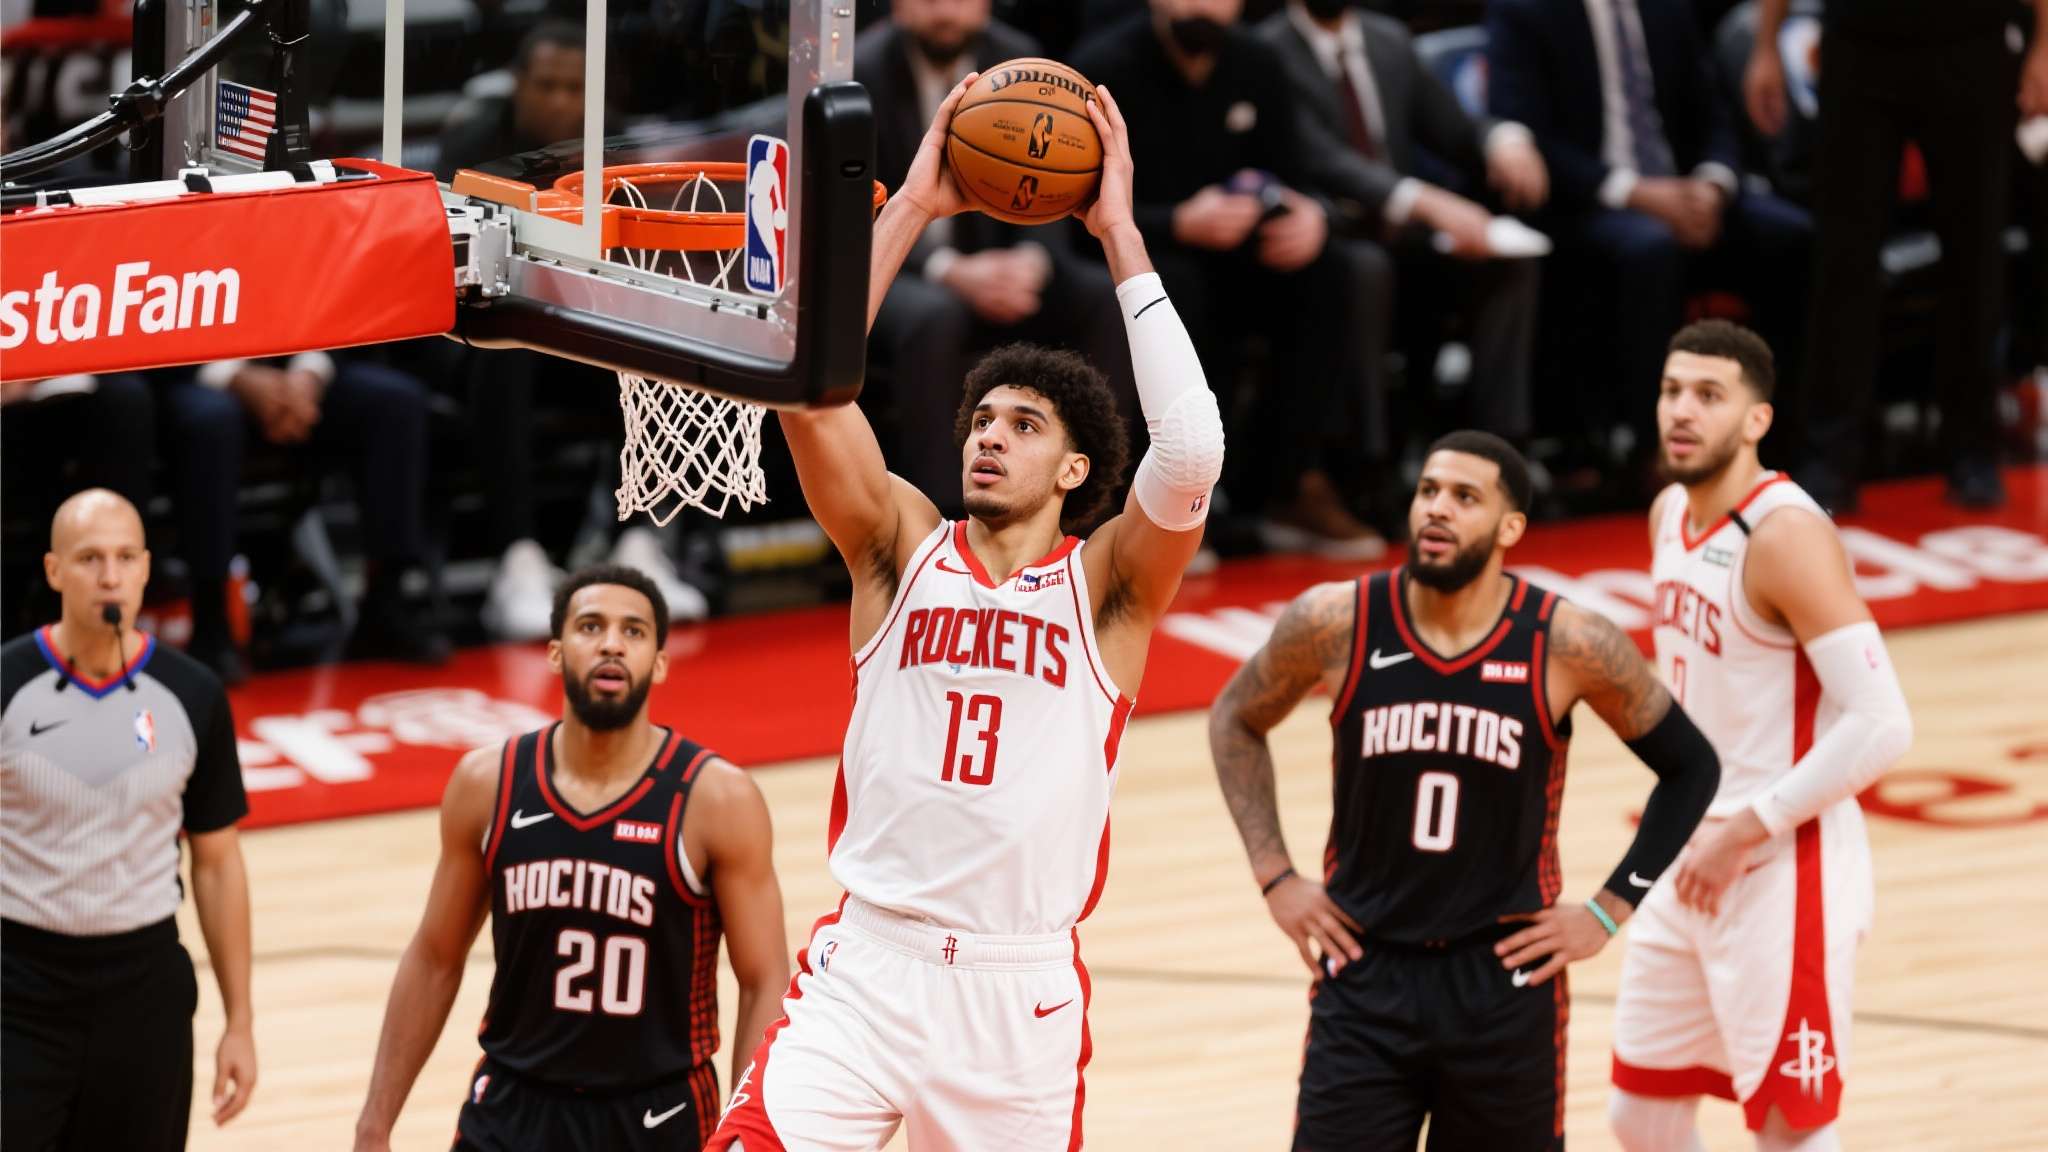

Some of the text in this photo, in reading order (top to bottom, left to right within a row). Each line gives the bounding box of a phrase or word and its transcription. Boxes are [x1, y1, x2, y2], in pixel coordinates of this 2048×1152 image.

[898, 607, 1070, 689] ROCKETS
[941, 690, 1003, 786] 13
[1412, 771, 1460, 852] 0
[554, 929, 647, 1016] 20
